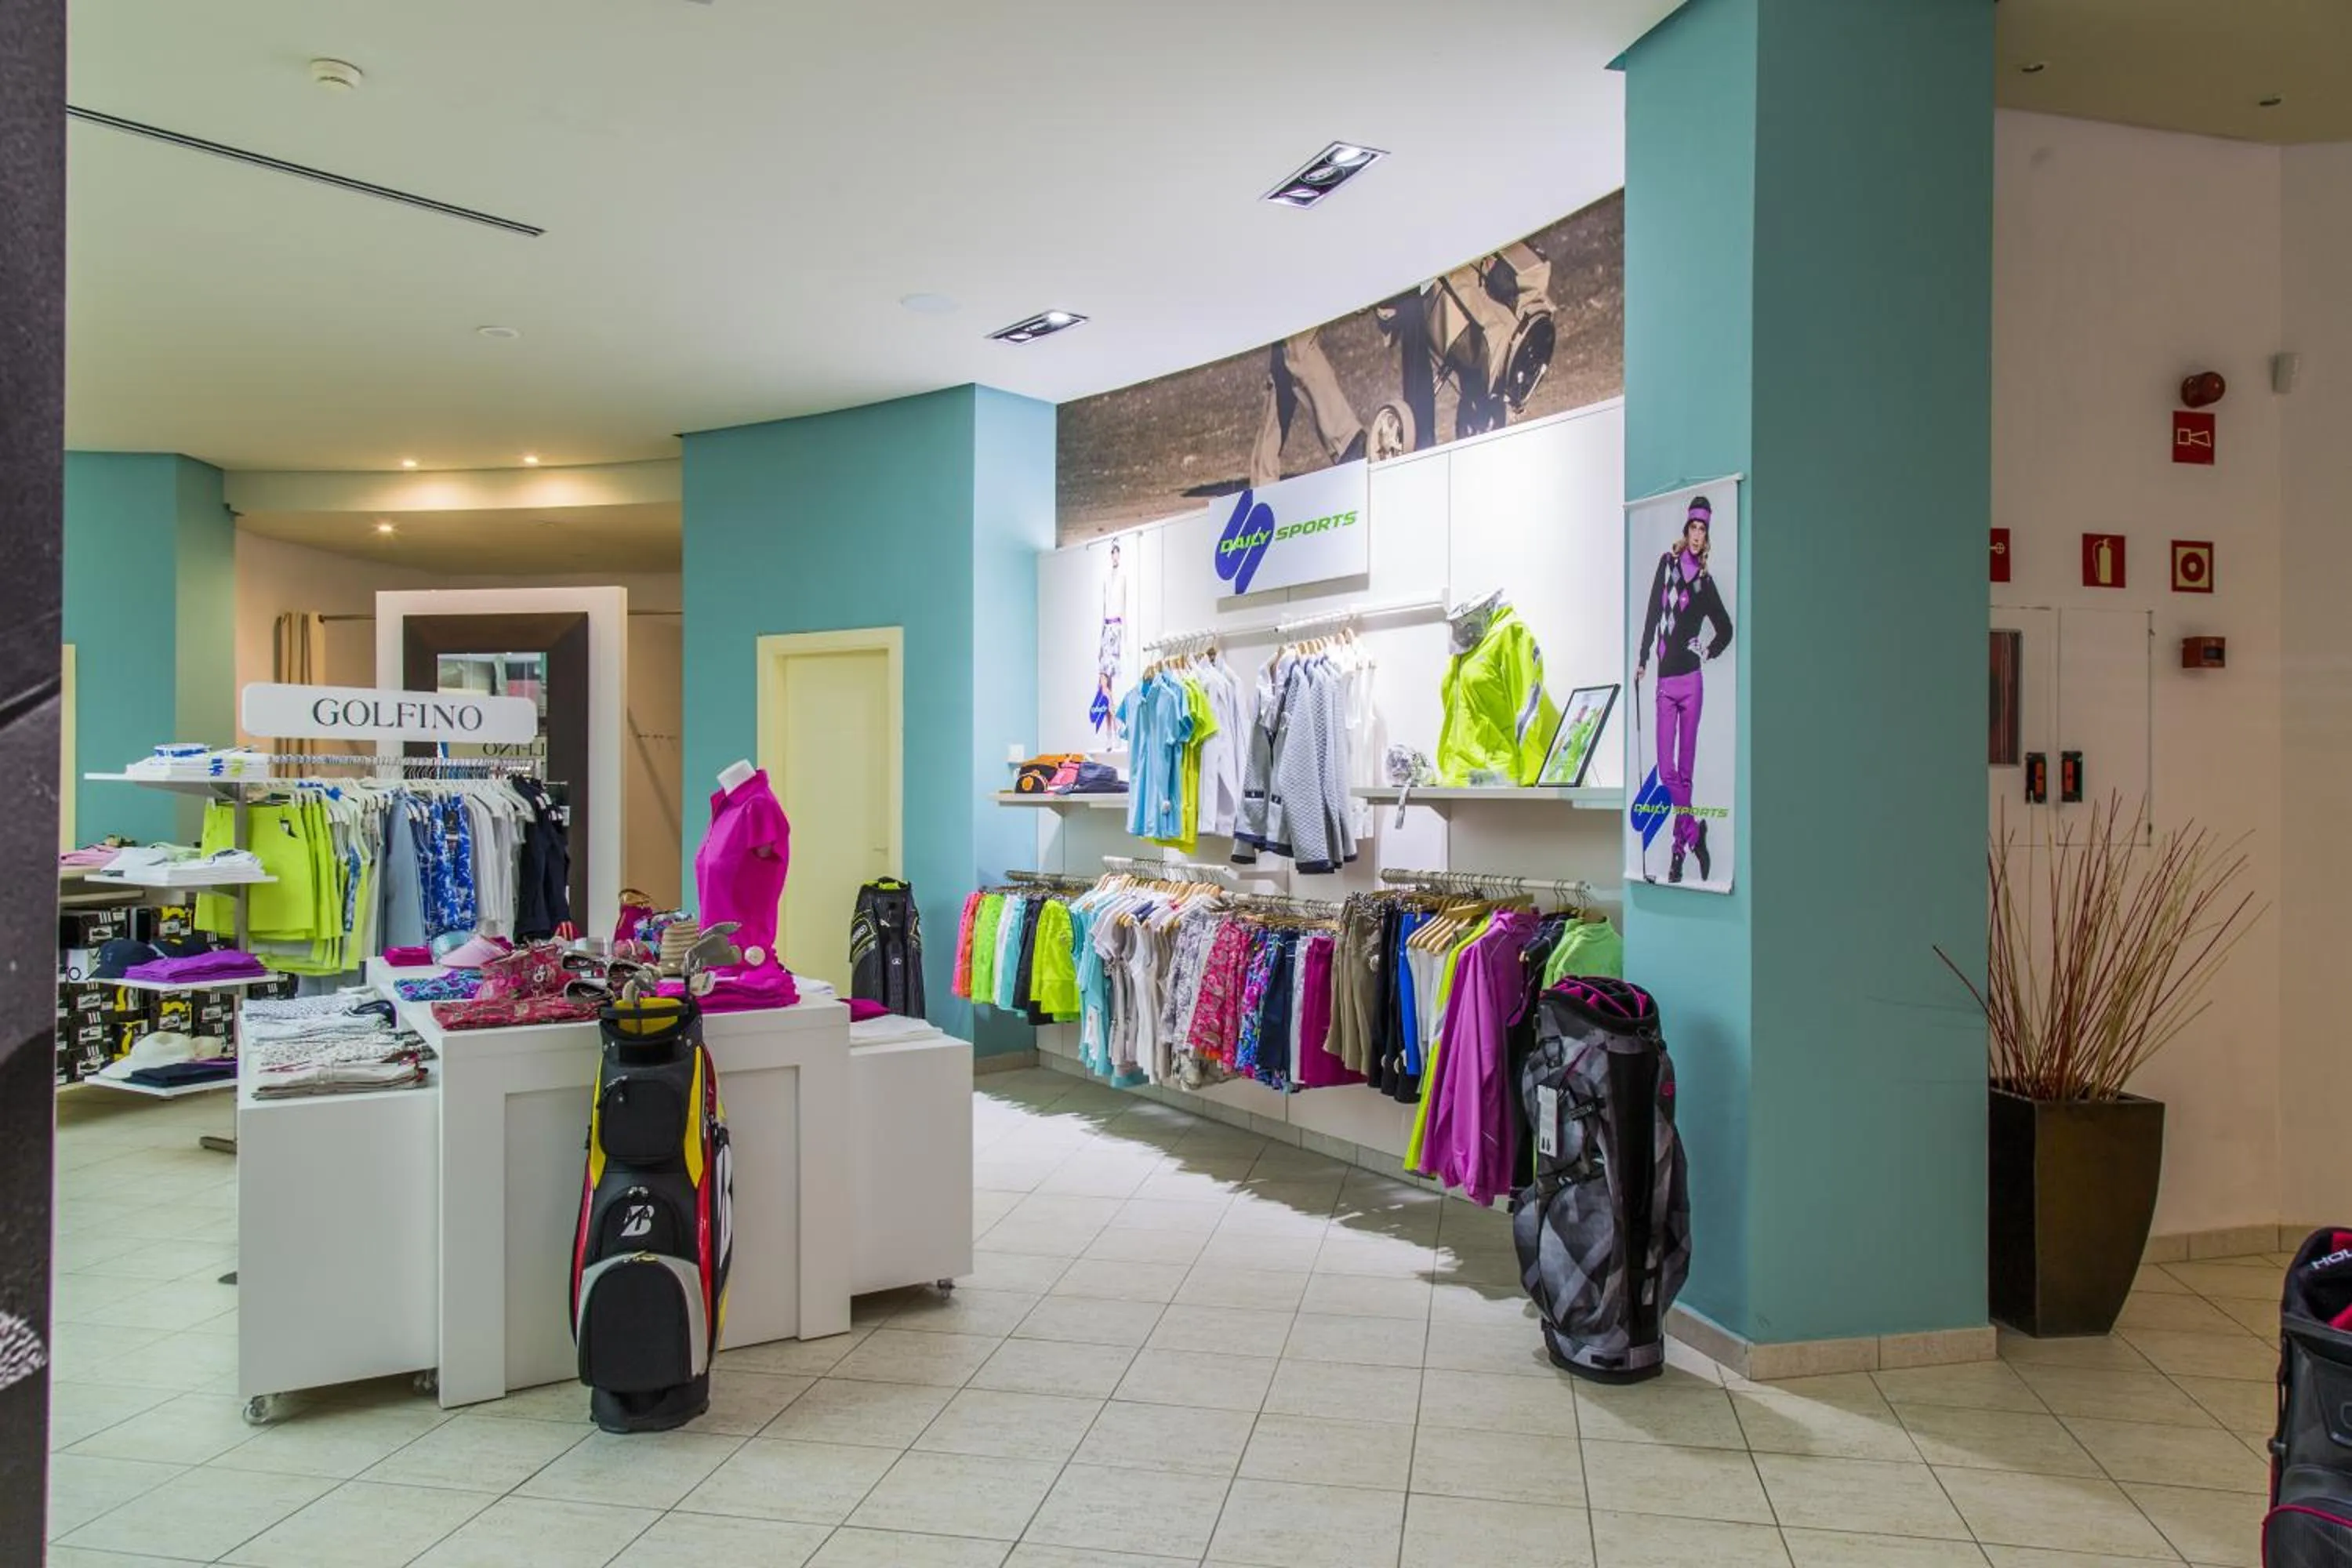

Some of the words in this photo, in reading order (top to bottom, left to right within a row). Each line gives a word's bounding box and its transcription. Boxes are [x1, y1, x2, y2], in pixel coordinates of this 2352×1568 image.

[1220, 530, 1271, 554] DAILY
[1275, 510, 1358, 541] SPORTS
[313, 698, 483, 731] GOLFINO
[1634, 804, 1669, 815] DAILY
[1671, 806, 1730, 818] SPORTS
